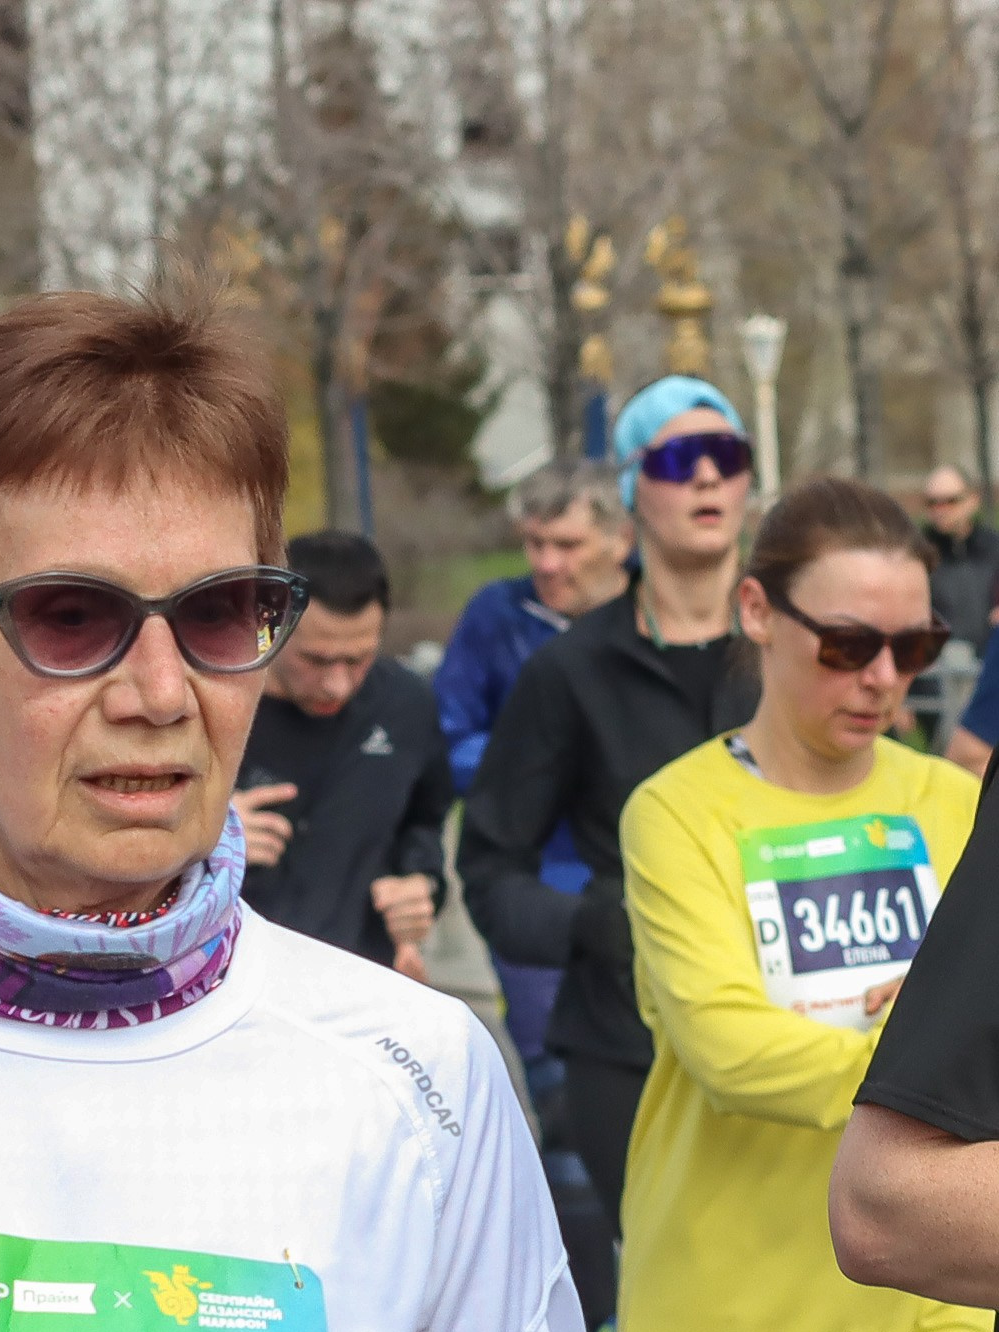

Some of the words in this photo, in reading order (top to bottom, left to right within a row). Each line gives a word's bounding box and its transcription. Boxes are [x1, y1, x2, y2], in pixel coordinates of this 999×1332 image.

[793, 886, 921, 951] 34661
[758, 917, 779, 945] D
[375, 1037, 462, 1138] NORDCAP
[22, 1288, 81, 1307] Прайм
[199, 1304, 283, 1320] КАЗАНСКИЙ
[199, 1316, 267, 1329] МАРАФОН
